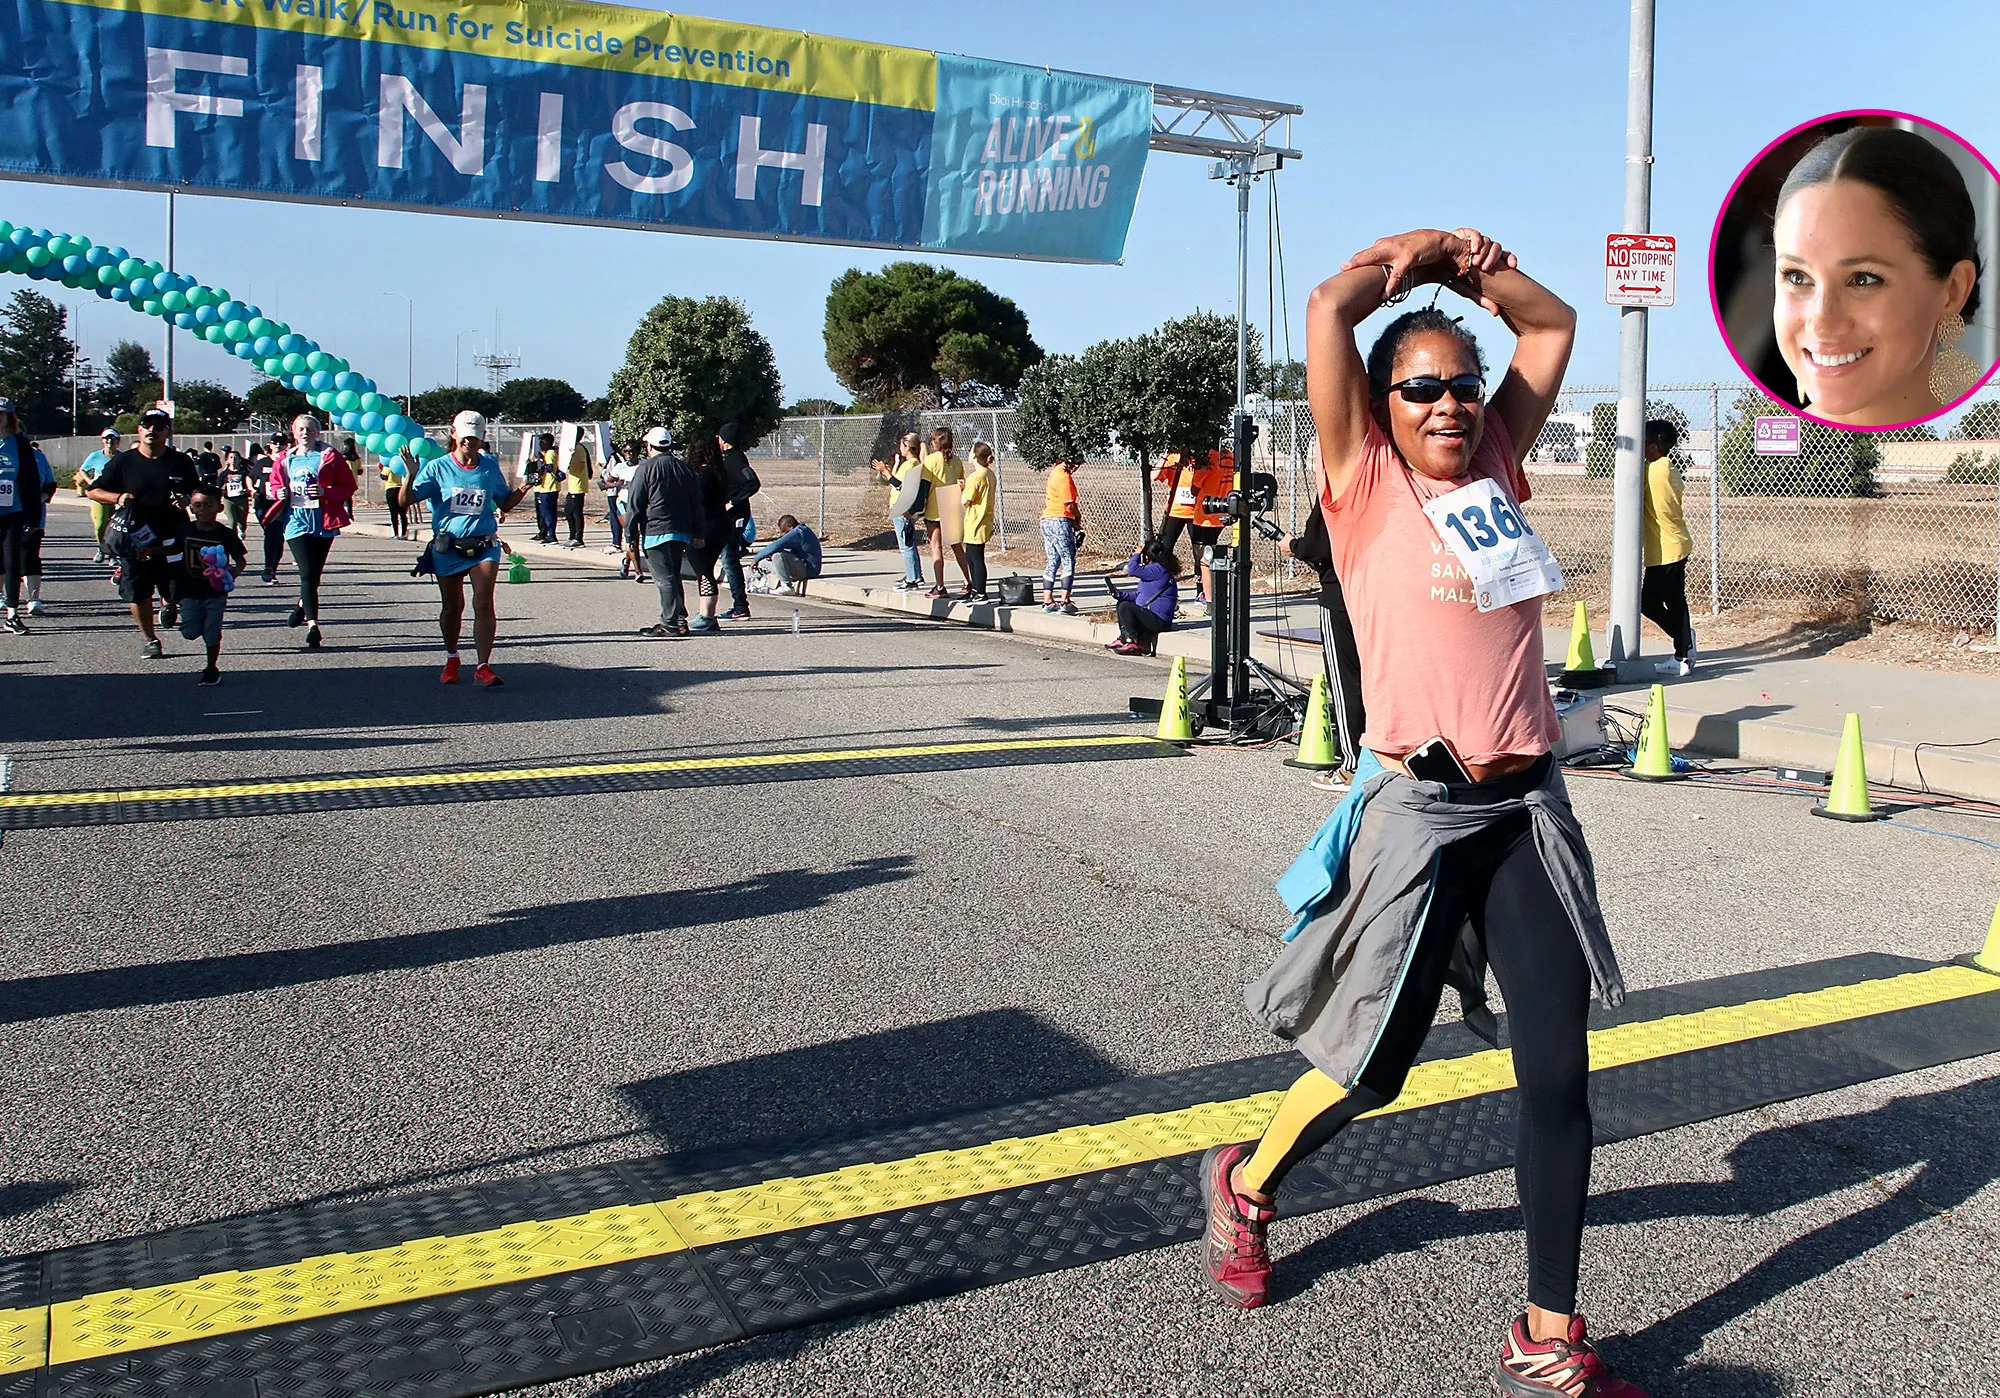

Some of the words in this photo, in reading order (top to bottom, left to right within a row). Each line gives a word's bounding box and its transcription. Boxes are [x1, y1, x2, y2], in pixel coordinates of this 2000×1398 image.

[447, 12, 493, 40] for
[505, 21, 623, 55] Suicide
[634, 36, 790, 77] Prevention
[989, 93, 1010, 105] Didi
[146, 46, 828, 207] FINISH
[980, 115, 1071, 164] ALIVE
[1075, 116, 1096, 160] &
[974, 164, 1110, 216] RUNNING
[1608, 248, 1629, 266] NO
[1631, 252, 1673, 266] STOPPING
[1616, 269, 1637, 281] ANY
[1642, 270, 1666, 282] TIME
[456, 493, 483, 507] 1245
[1430, 562, 1470, 580] SAN
